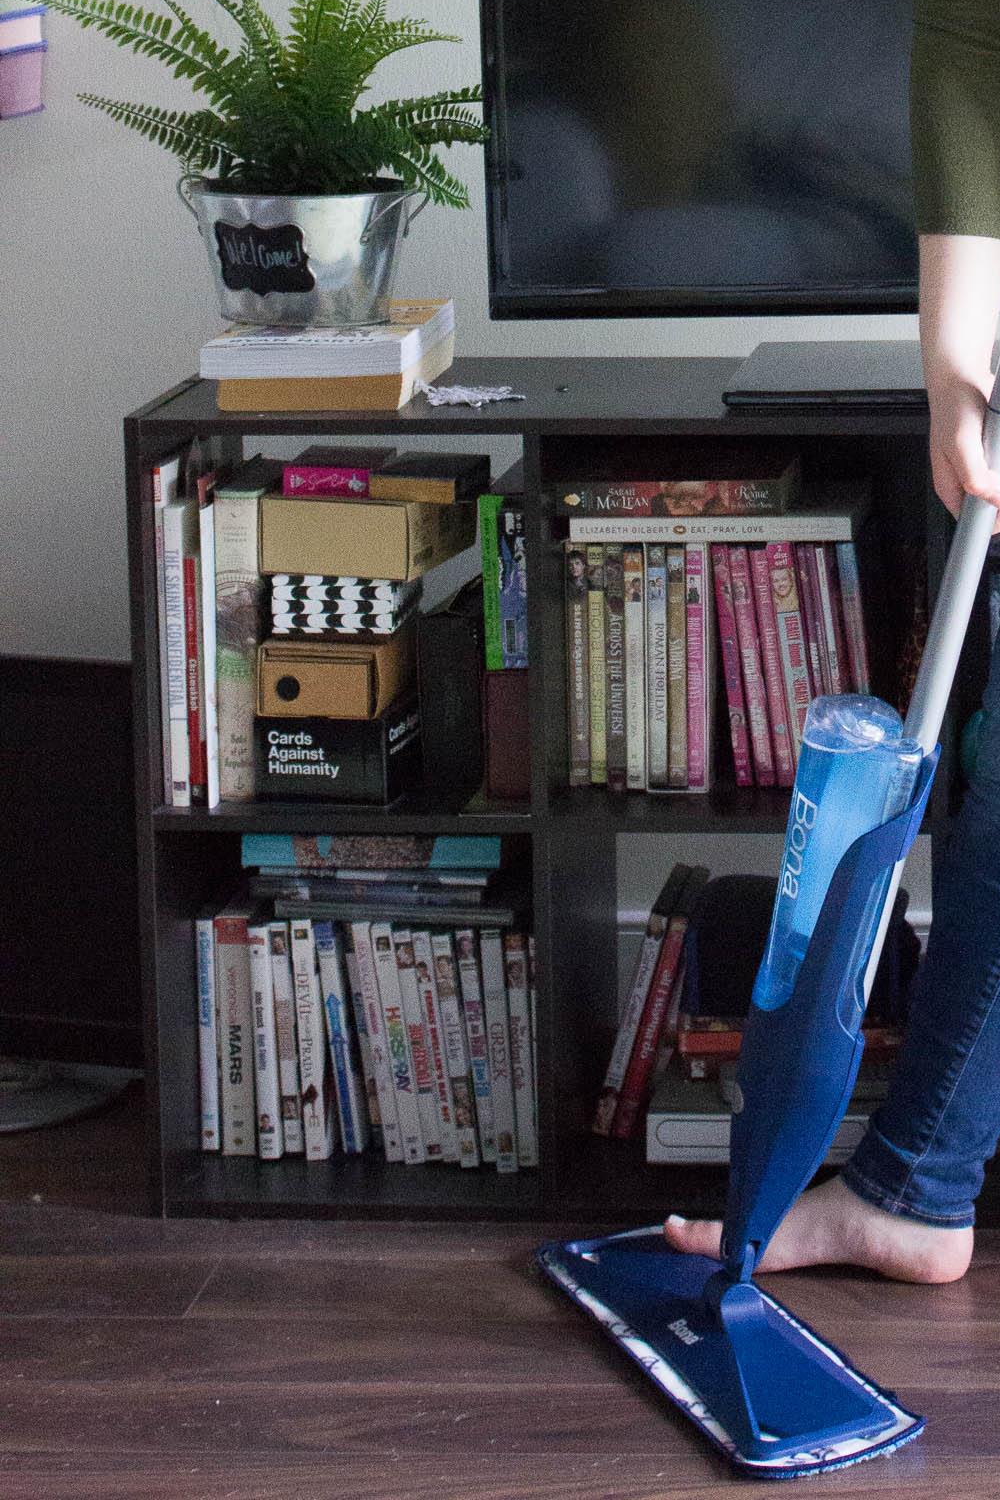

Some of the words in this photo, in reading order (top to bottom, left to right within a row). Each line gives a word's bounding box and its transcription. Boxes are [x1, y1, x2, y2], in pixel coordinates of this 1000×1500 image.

[579, 526, 629, 535] ELIZABETH
[690, 525, 711, 536] EAT,
[712, 525, 740, 536] PRAY,
[741, 525, 765, 534] LOVE
[166, 550, 180, 569] THE
[166, 576, 181, 619] SKINNY
[757, 585, 772, 604] just
[608, 614, 622, 656] ACROSS
[655, 622, 664, 667] ROMAN
[167, 624, 184, 707] CONFIDENTIAL
[608, 659, 624, 680] THE
[670, 639, 682, 680] SABRINA
[611, 683, 624, 736] UNIVERSE
[655, 671, 665, 724] HOLIDAY
[268, 730, 312, 746] Cards
[268, 745, 325, 762] Against
[268, 760, 339, 779] Humanity
[782, 790, 819, 901] Bona
[296, 972, 313, 1018] DEVIL
[229, 1024, 242, 1085] MARS
[301, 1038, 313, 1080] PRADA
[386, 1007, 412, 1094] HAIRSPRAY
